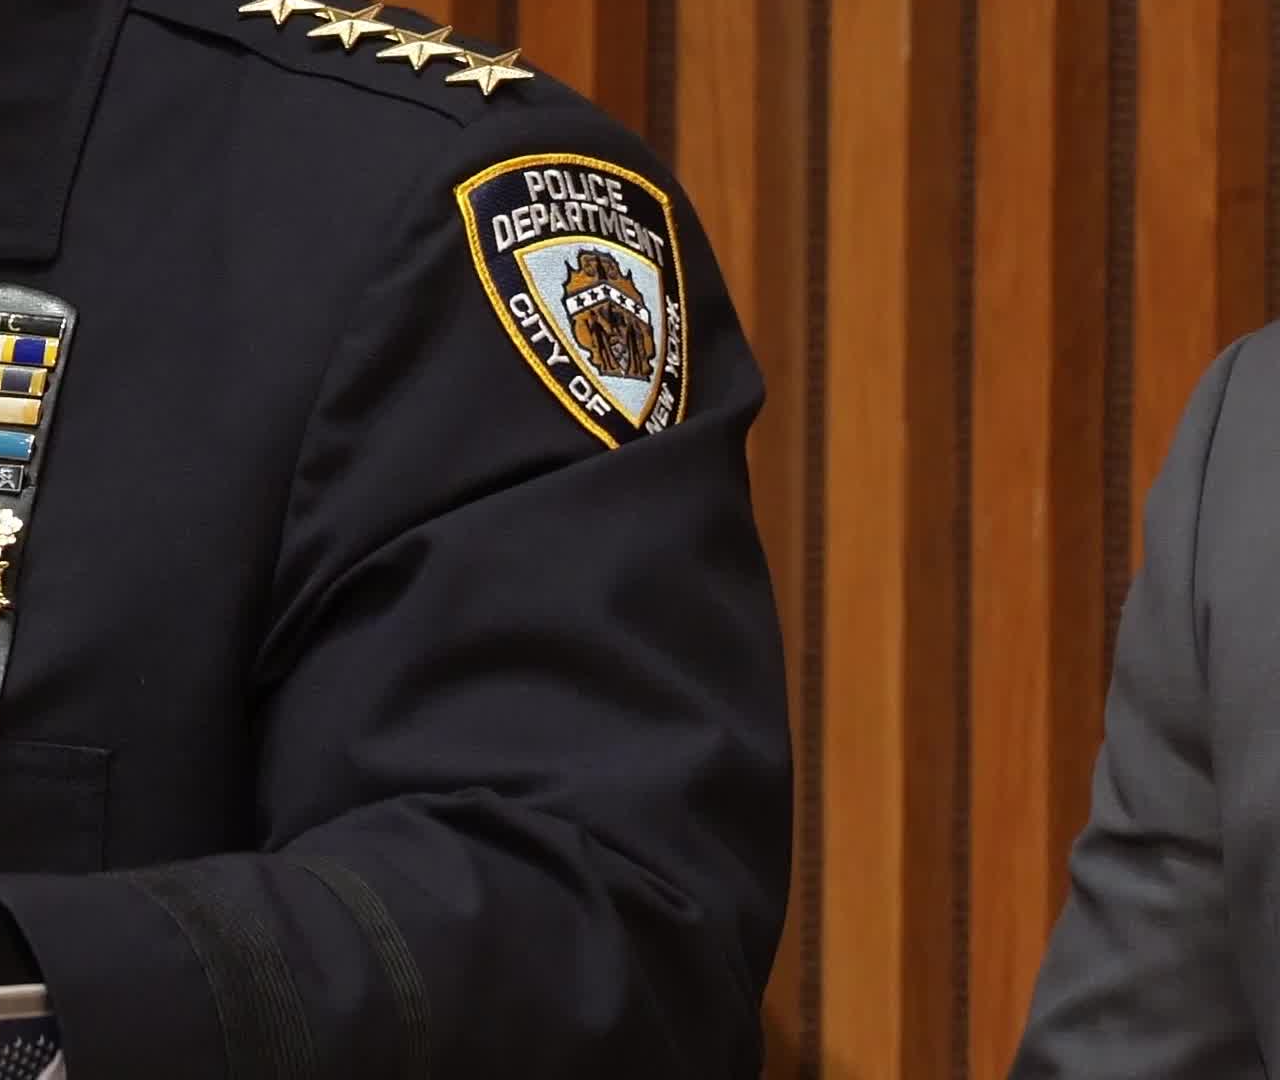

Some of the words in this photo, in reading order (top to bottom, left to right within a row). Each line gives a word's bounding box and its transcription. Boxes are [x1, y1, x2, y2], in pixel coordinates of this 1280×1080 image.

[523, 169, 628, 214] POLICE
[491, 200, 665, 267] DEPARTMENT
[508, 291, 571, 367] CITY
[568, 375, 612, 417] OF
[644, 381, 676, 436] NEW
